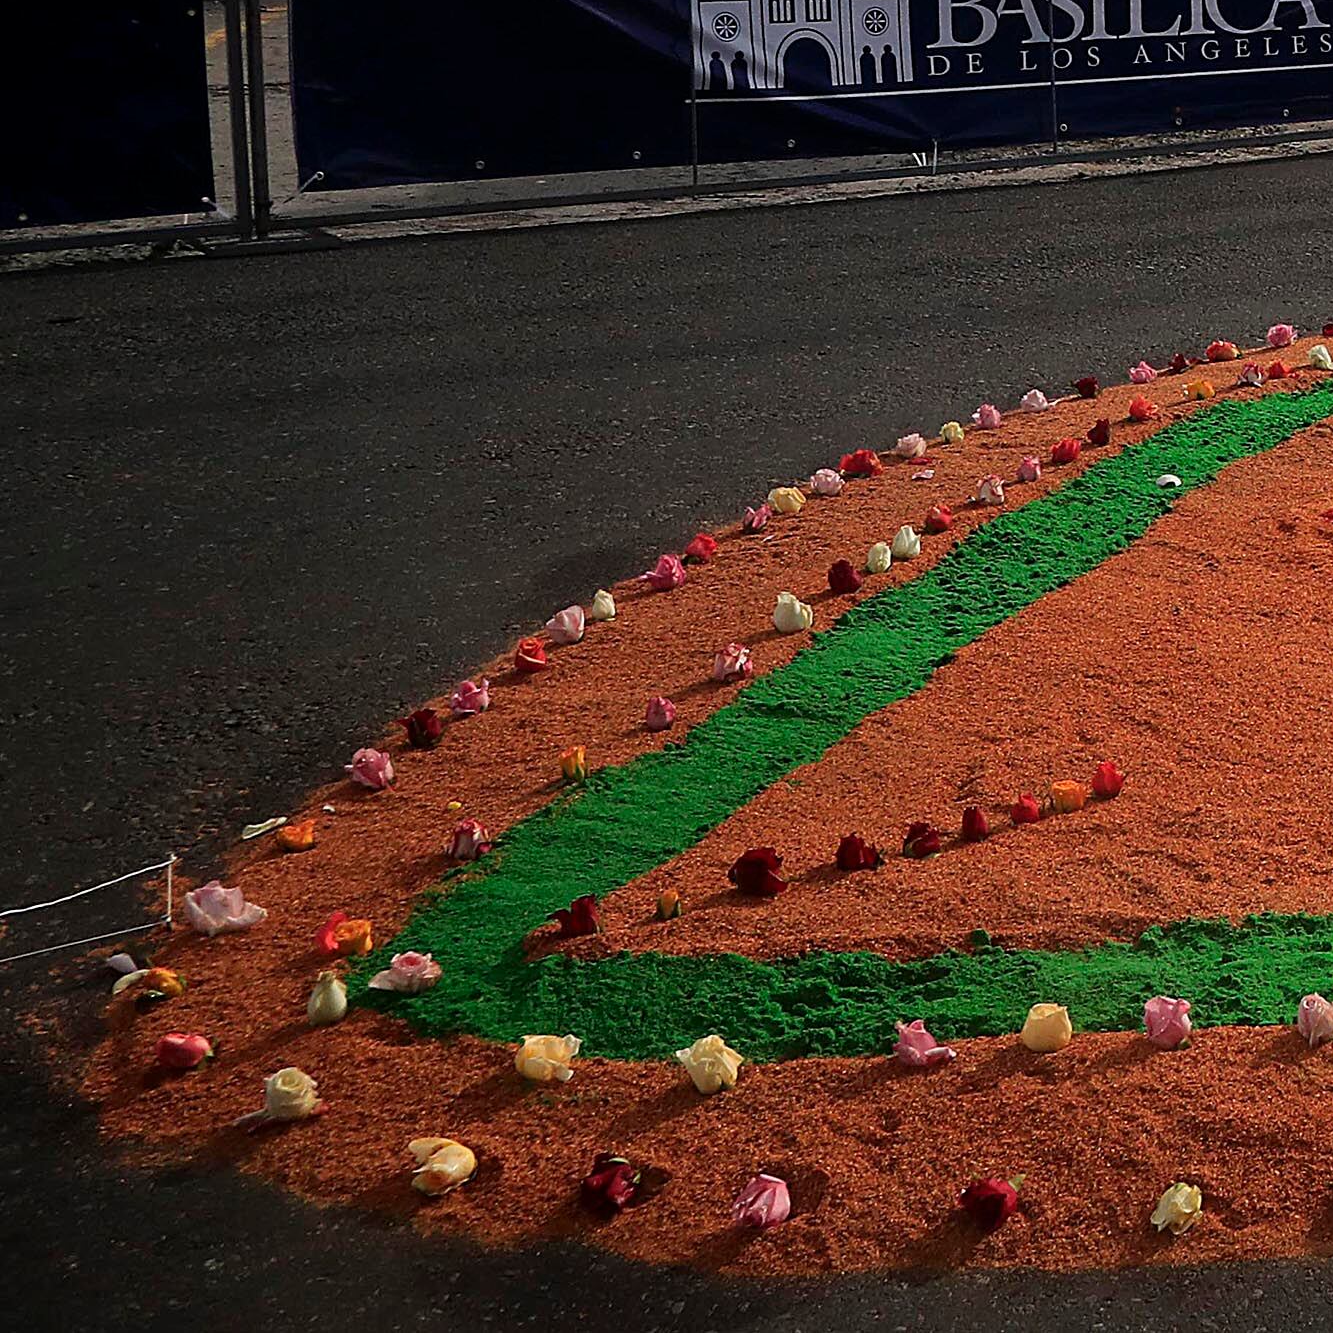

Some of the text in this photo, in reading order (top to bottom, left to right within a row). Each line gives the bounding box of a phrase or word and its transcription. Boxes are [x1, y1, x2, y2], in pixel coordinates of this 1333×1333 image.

[928, 33, 1333, 77] DE LOS ANGELES
